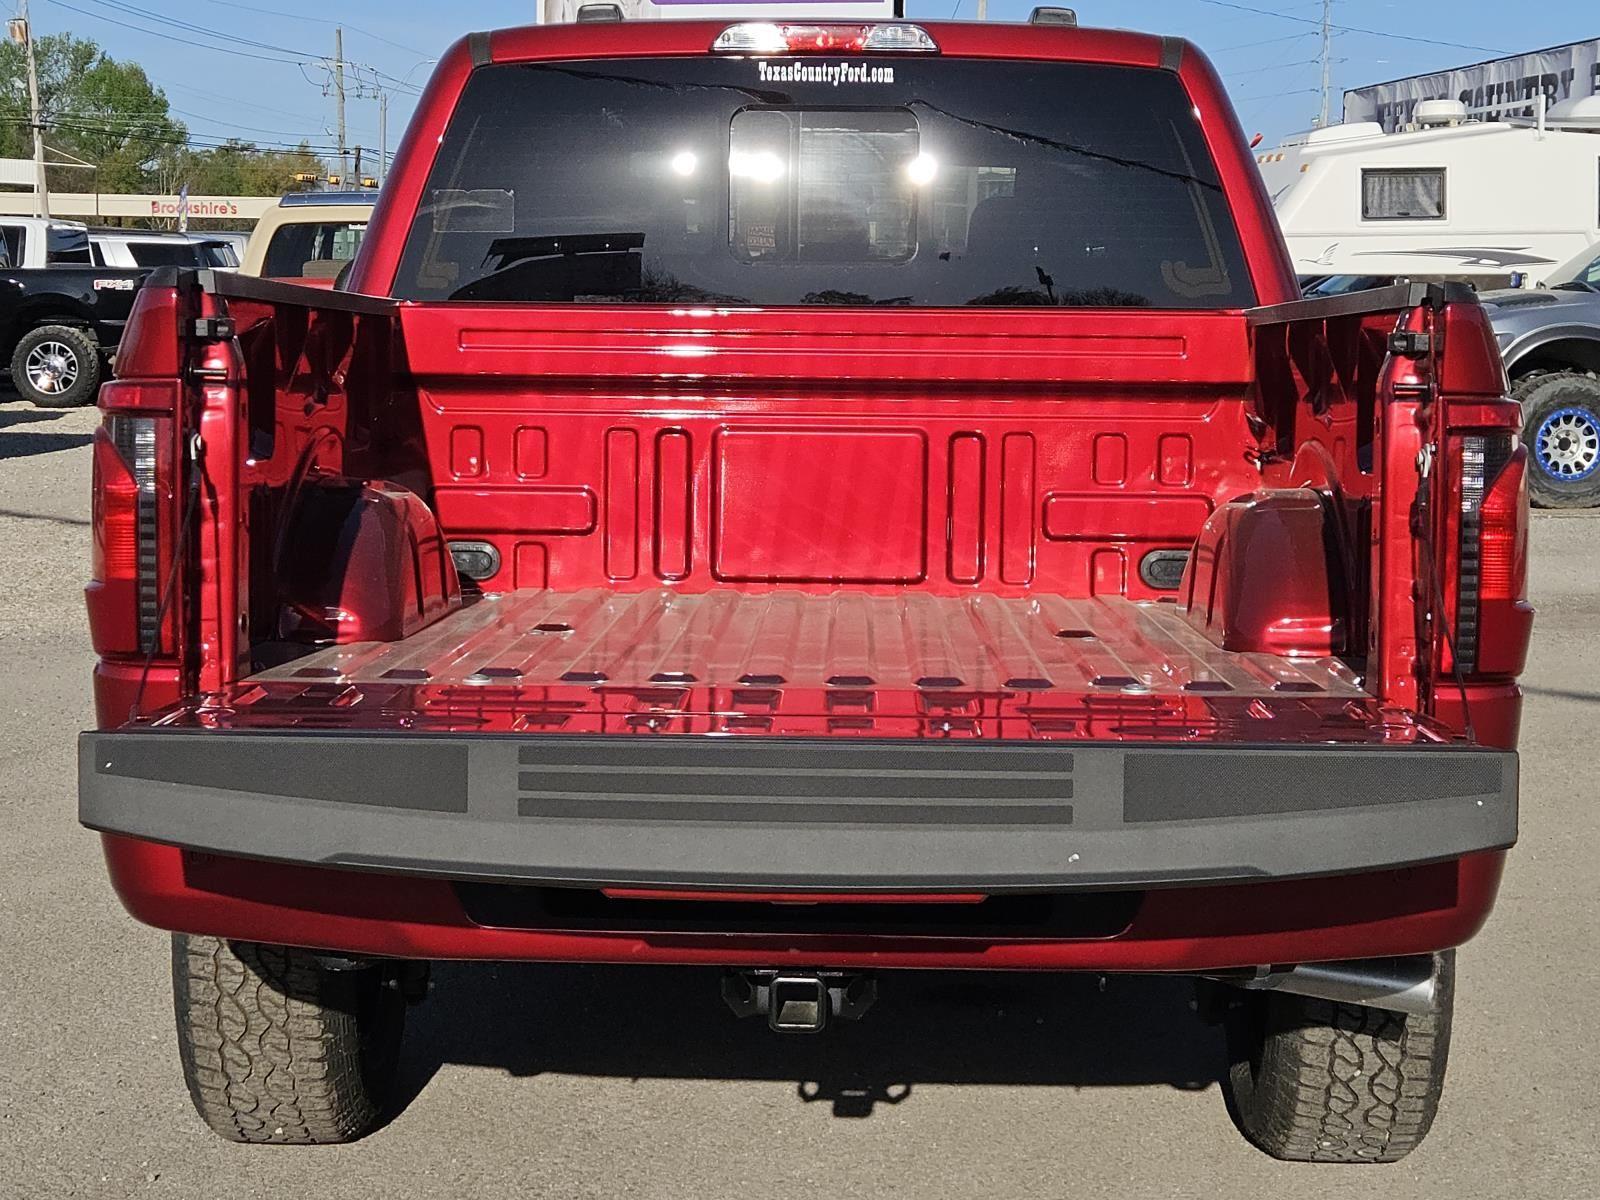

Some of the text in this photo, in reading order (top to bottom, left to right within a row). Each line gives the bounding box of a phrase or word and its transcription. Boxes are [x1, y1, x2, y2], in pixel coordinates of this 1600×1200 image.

[758, 61, 894, 86] TexasCountryFord.com
[151, 200, 237, 215] Brokshire's
[94, 279, 134, 290] FX4
